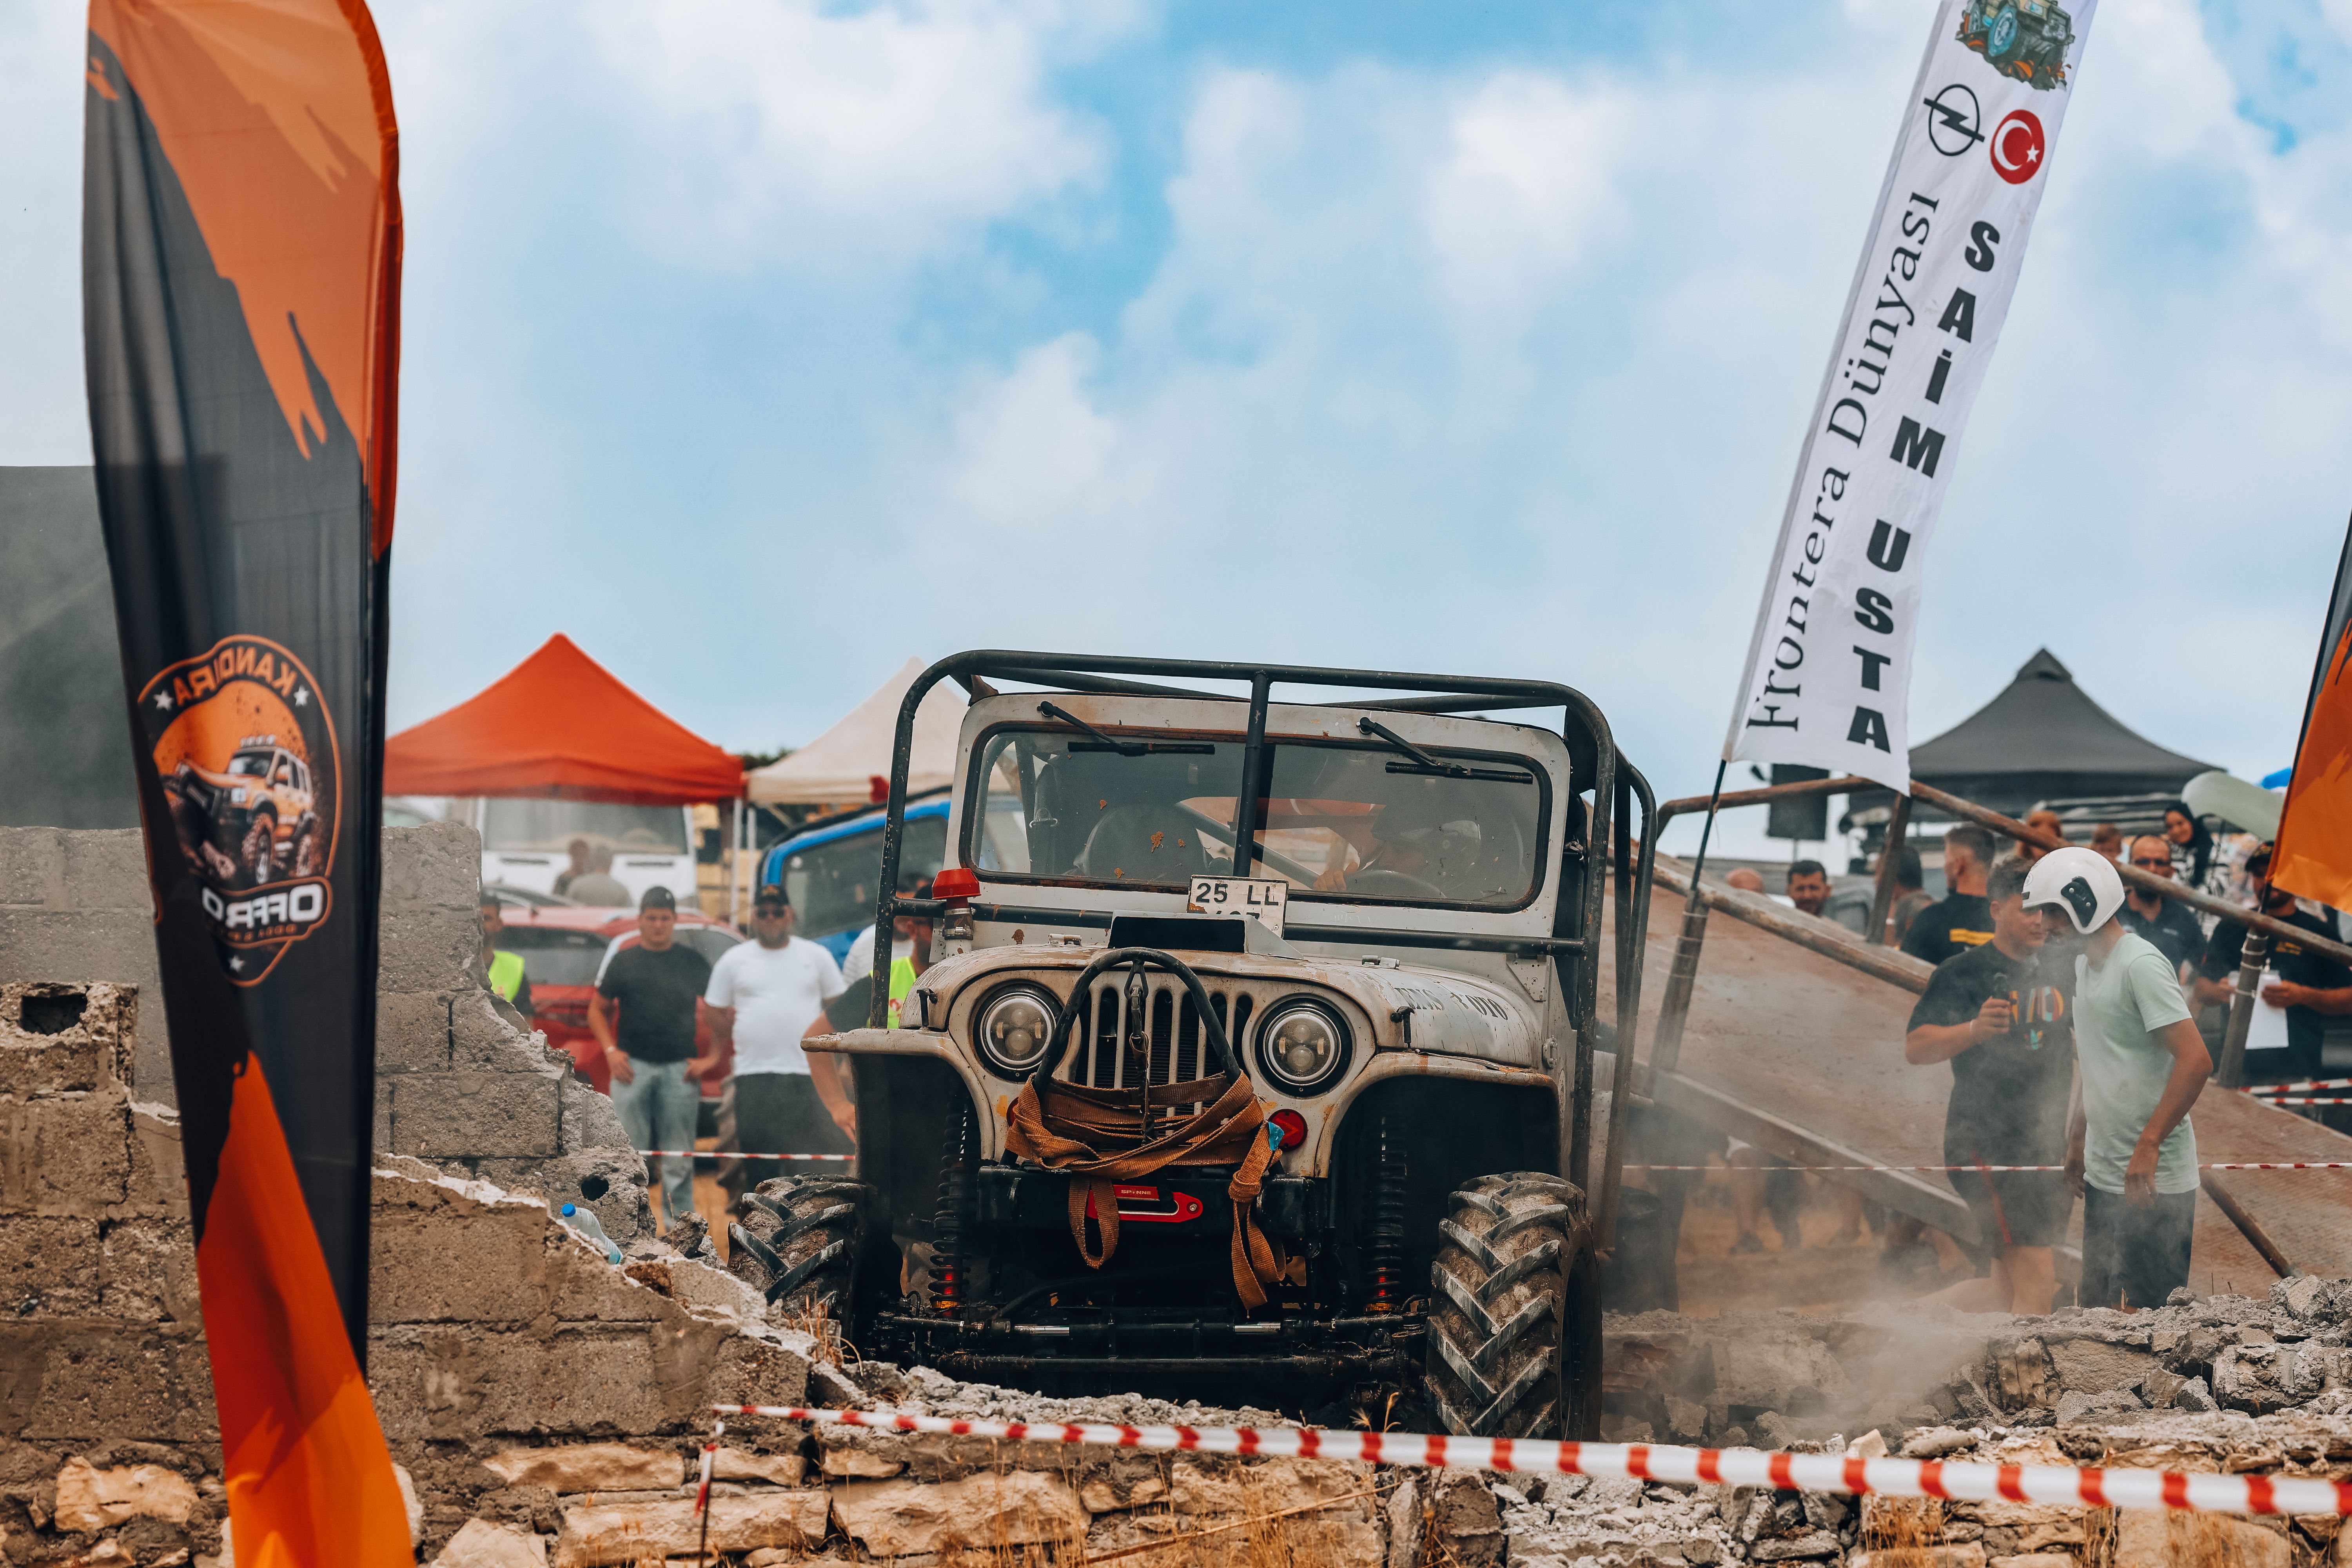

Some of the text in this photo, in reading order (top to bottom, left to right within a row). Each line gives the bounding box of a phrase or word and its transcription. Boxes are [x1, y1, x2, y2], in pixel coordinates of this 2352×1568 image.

[1746, 192, 1940, 732] Frontera Dünyası
[1847, 519, 1911, 754] USTA
[1196, 882, 1279, 906] 25 LL
